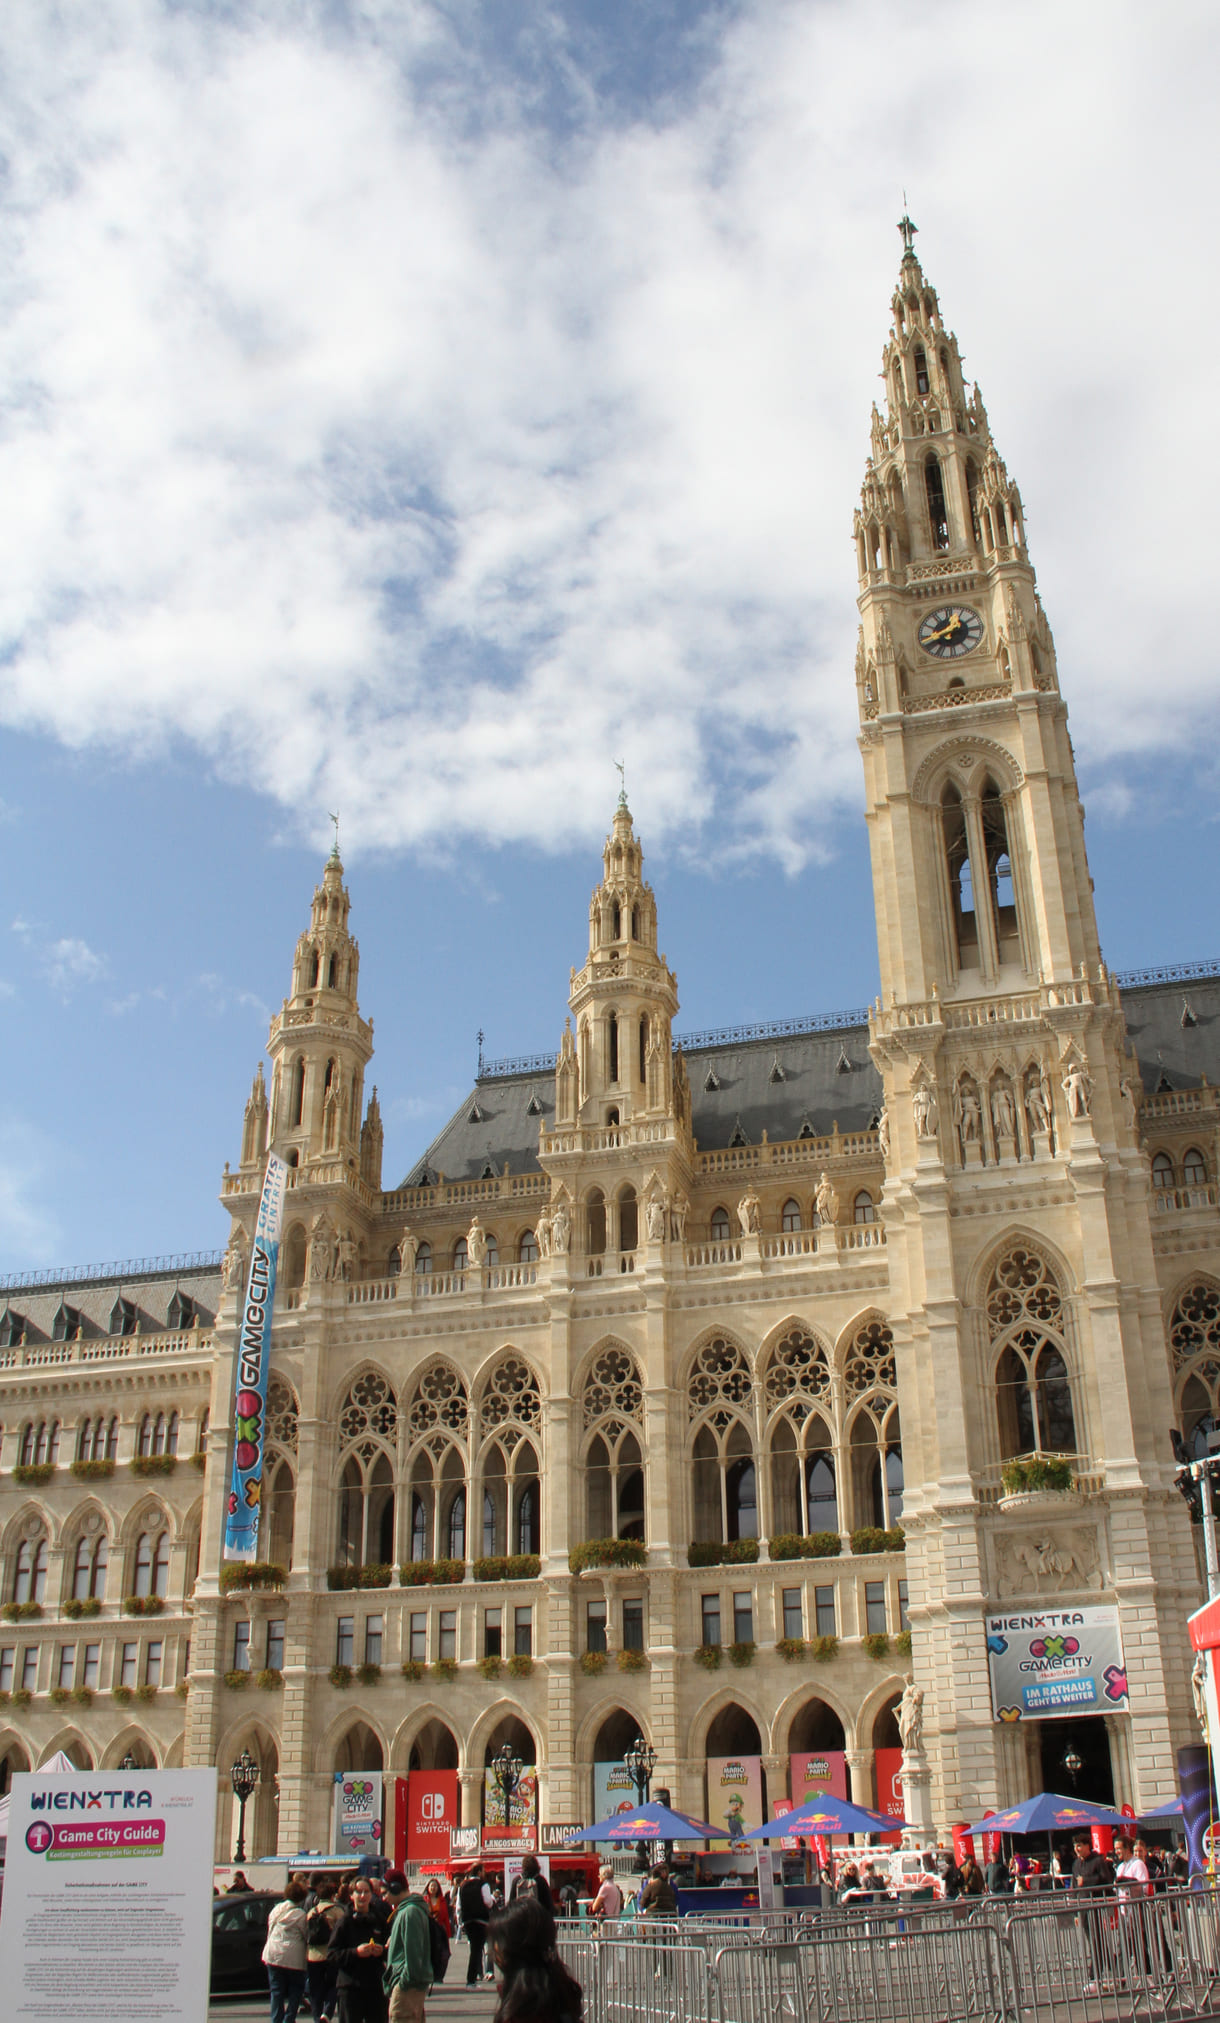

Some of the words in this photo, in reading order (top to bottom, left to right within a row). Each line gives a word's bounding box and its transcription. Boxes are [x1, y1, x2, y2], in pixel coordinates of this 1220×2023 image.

[258, 1158, 278, 1228] GRATIS
[266, 1162, 284, 1233] EINTRITT
[990, 1613, 1084, 1631] WIENXTRA
[1026, 1689, 1041, 1699] IM
[1042, 1681, 1093, 1697] RATHAUS
[1028, 1697, 1050, 1707] GEHT
[1051, 1695, 1062, 1704] ES
[1062, 1691, 1095, 1703] WEITER
[31, 1789, 153, 1810] WIENXTRA
[59, 1829, 94, 1843] Game
[96, 1827, 121, 1845] City
[123, 1825, 160, 1840] Guide
[416, 1826, 450, 1834] SWITCH
[788, 1822, 816, 1833] Red
[816, 1821, 842, 1831] Bull
